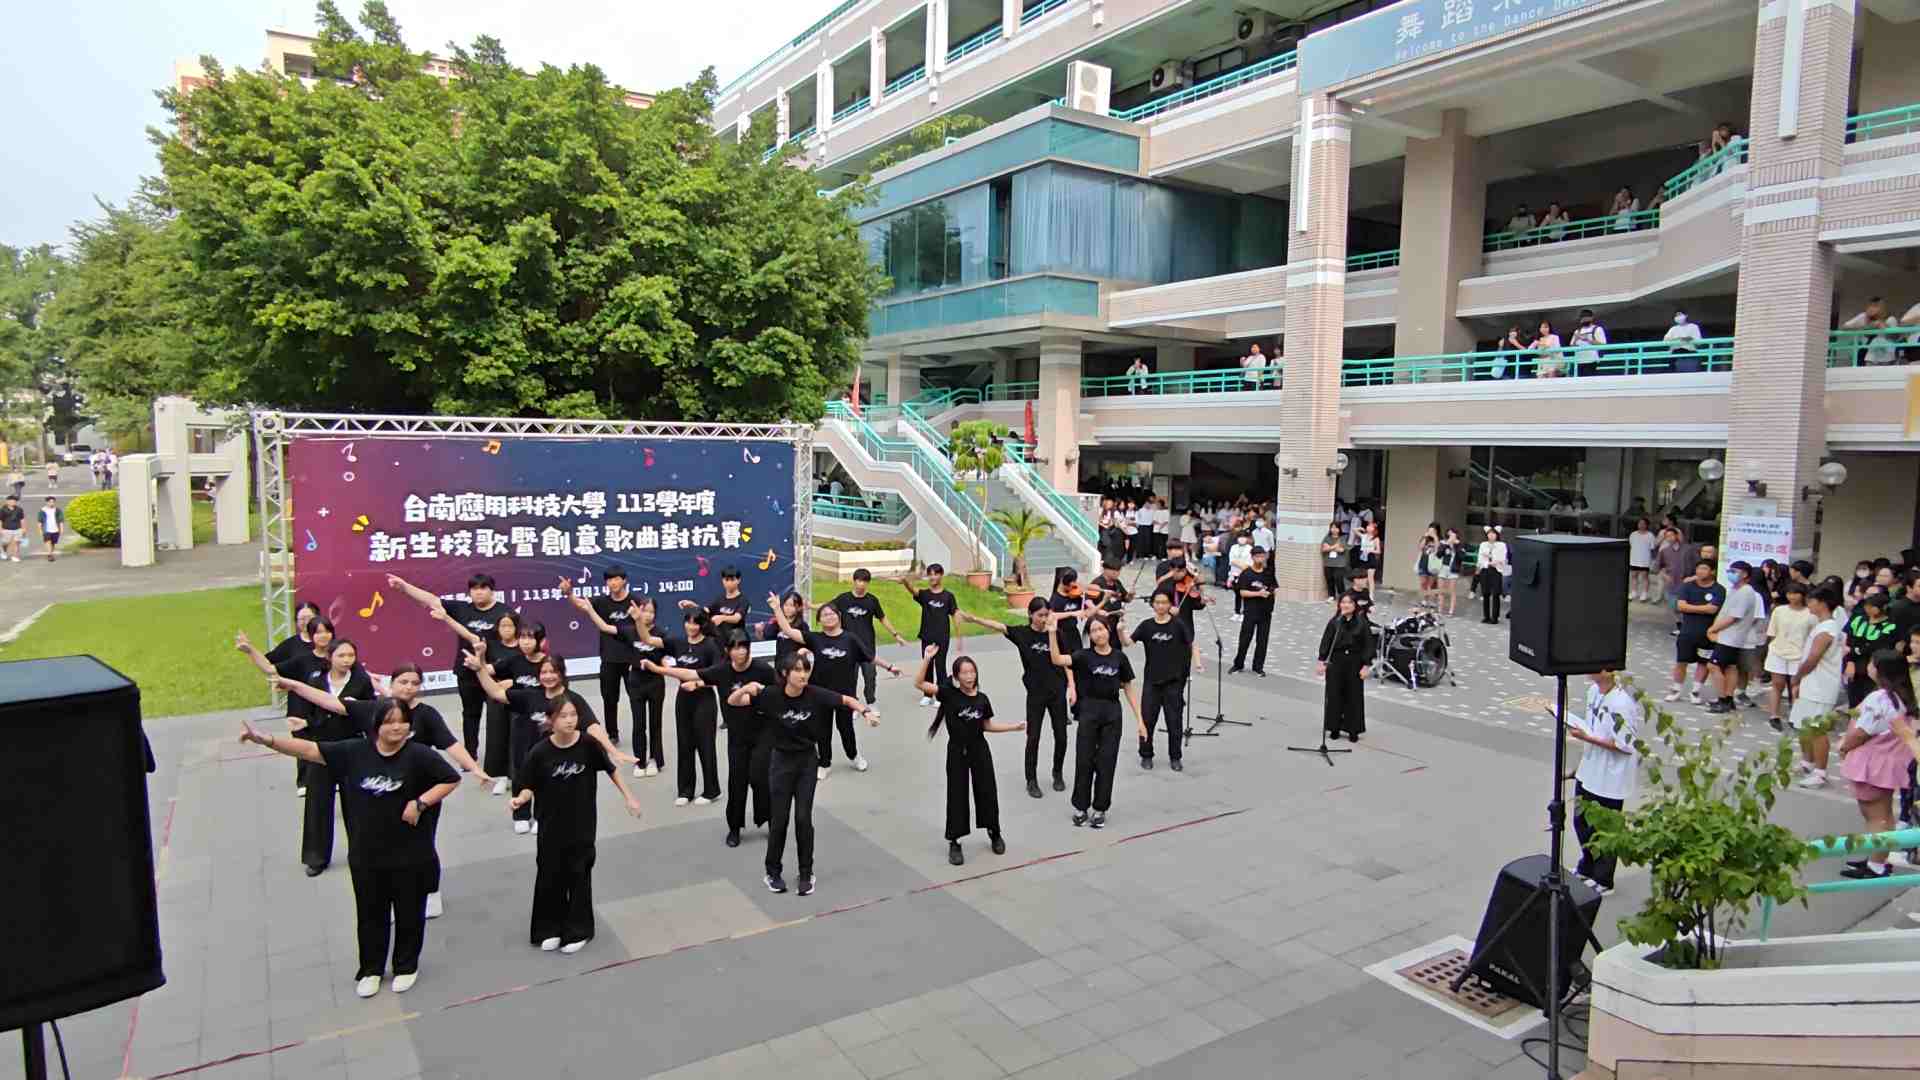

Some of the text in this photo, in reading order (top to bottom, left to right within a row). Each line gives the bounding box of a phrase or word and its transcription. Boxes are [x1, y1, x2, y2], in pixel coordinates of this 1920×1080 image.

[1504, 6, 1544, 26] Dance
[403, 490, 716, 523] 台南應用科技大學 113學年度
[369, 521, 741, 562] 新生校歌暨創意歌曲對抗賽
[659, 580, 694, 592] 14:00
